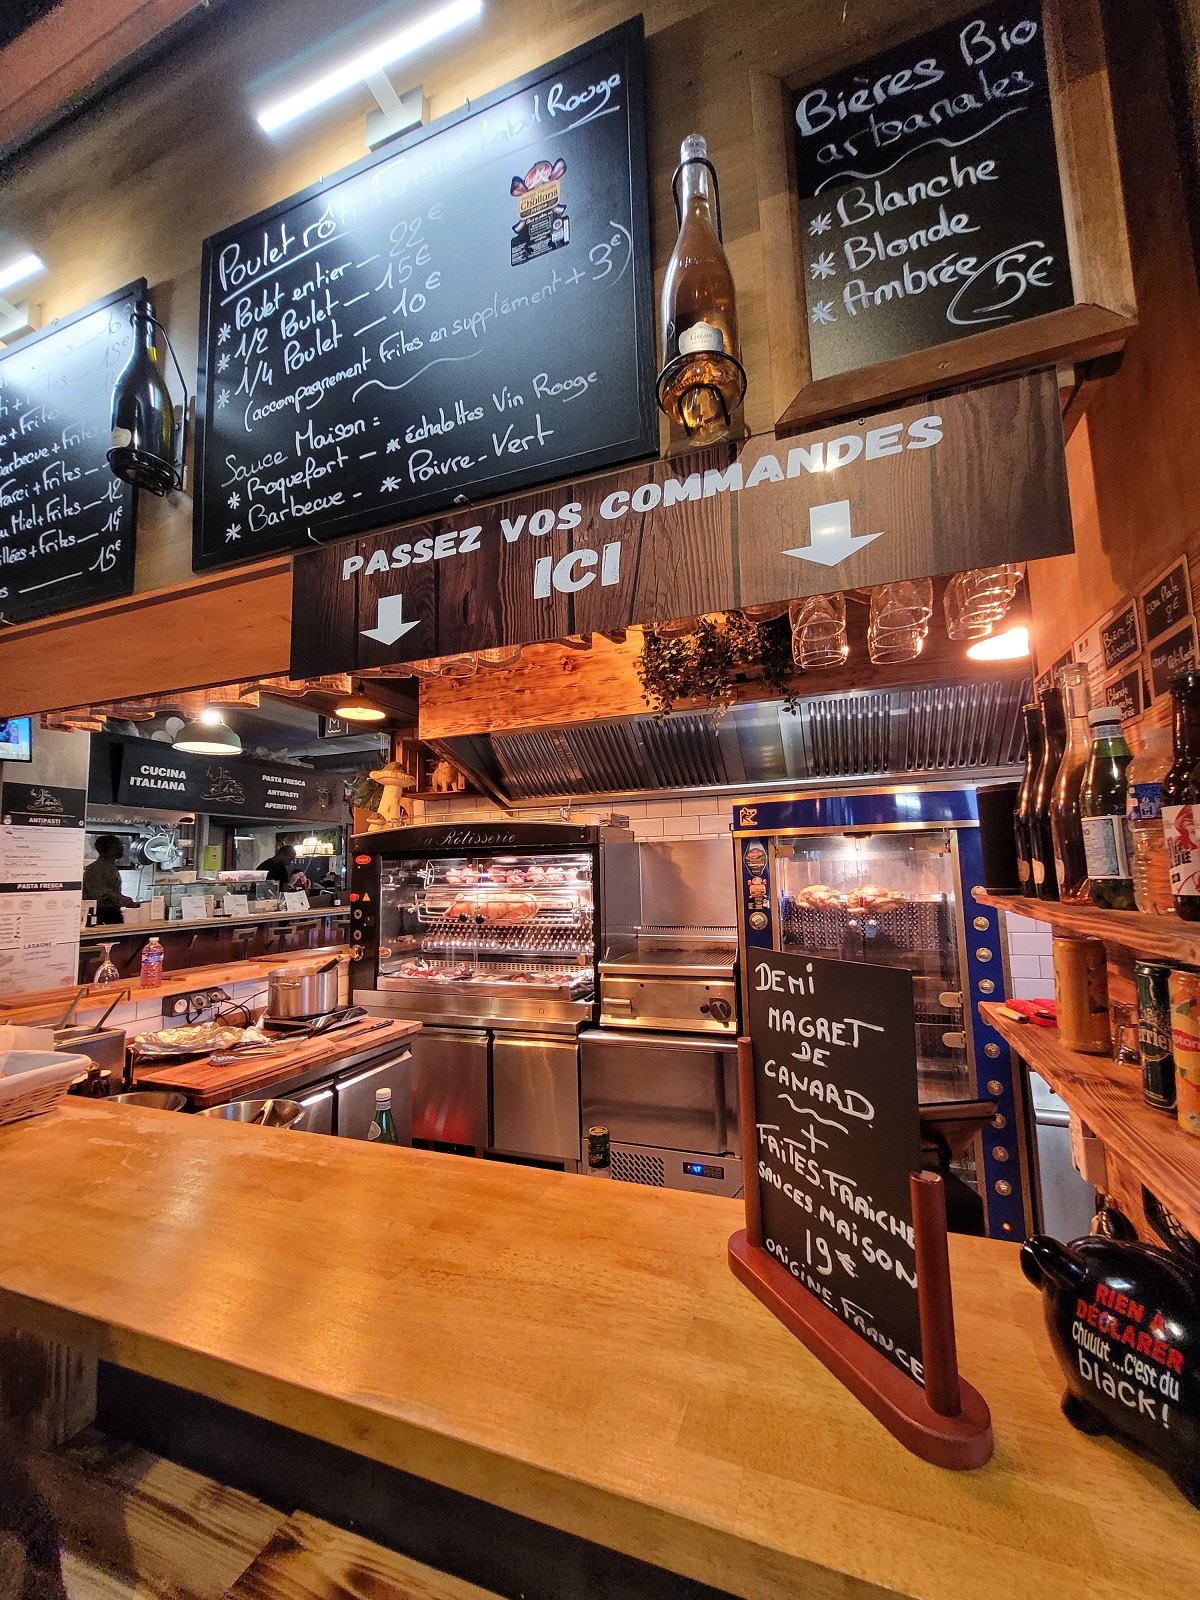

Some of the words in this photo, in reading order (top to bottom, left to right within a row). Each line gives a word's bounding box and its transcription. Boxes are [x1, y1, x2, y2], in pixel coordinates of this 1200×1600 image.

[795, 58, 945, 137] Bières
[959, 19, 1038, 66] Bio
[836, 155, 999, 228] Blanche
[219, 222, 296, 292] Poulet
[843, 203, 981, 273] Blonde
[292, 262, 354, 304] entier
[842, 253, 978, 315] Ambrée
[235, 330, 269, 366] 1/2
[280, 292, 336, 339] Poulet
[235, 355, 273, 398] 1/4
[284, 321, 344, 374] Poulet
[220, 446, 289, 488] Sauce
[295, 419, 366, 457] Maison
[246, 445, 350, 504] Roquefort
[492, 385, 525, 414] Vin
[247, 488, 346, 533] Barbecue
[342, 526, 483, 583] PASSEZ
[500, 503, 583, 546] VOS
[600, 414, 945, 521] COMMANDES
[533, 541, 623, 601] ICI
[129, 776, 186, 792] ITALIANA
[140, 765, 187, 780] CUCINA
[262, 774, 283, 784] PASTA
[283, 777, 306, 787] FRESCA
[267, 789, 299, 799] ANTIPASTI
[28, 817, 61, 825] ANTIPASTI
[264, 802, 297, 811] APERITIVO
[791, 1041, 831, 1068] DE
[1096, 1283, 1144, 1323] RIEN
[1076, 1299, 1185, 1375] DÉCLARER
[1160, 1371, 1179, 1402] du
